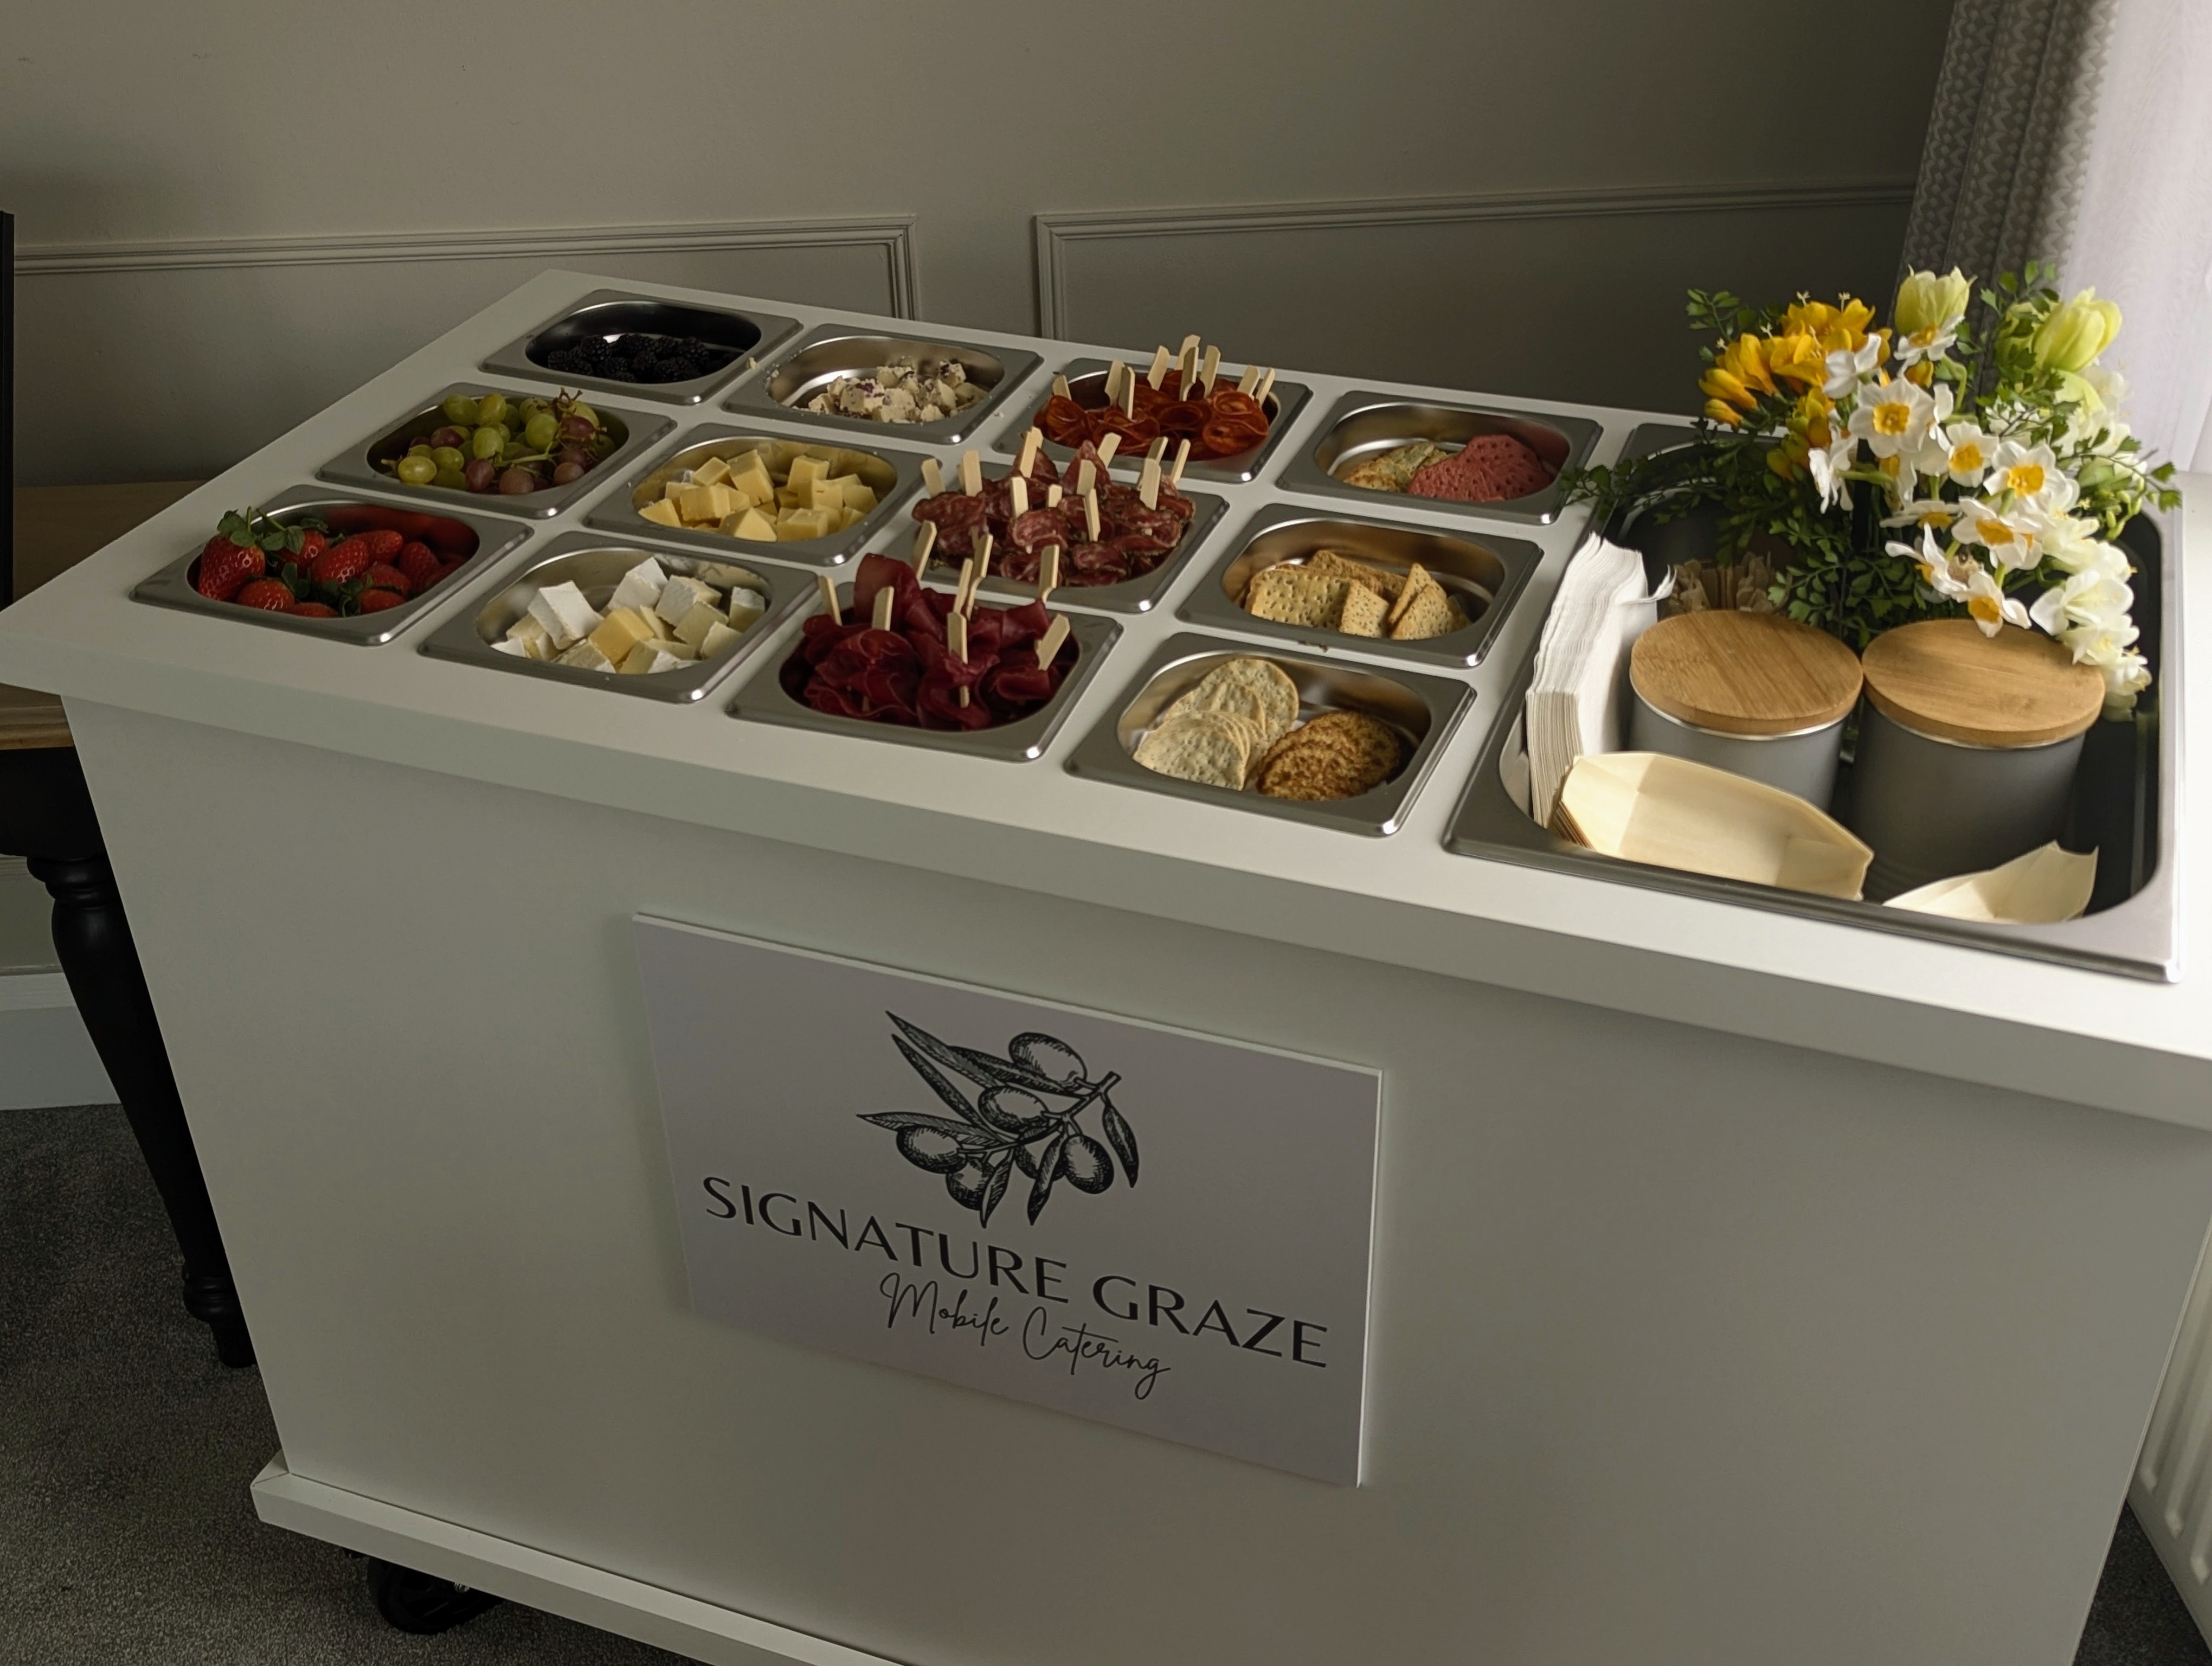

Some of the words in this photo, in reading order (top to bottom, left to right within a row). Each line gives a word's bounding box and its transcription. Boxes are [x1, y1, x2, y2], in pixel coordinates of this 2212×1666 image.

[703, 1177, 1069, 1304] SIGNATURE
[1092, 1276, 1328, 1368] GRAZE
[879, 1272, 1009, 1347] Mobile
[1023, 1306, 1171, 1400] Catering
